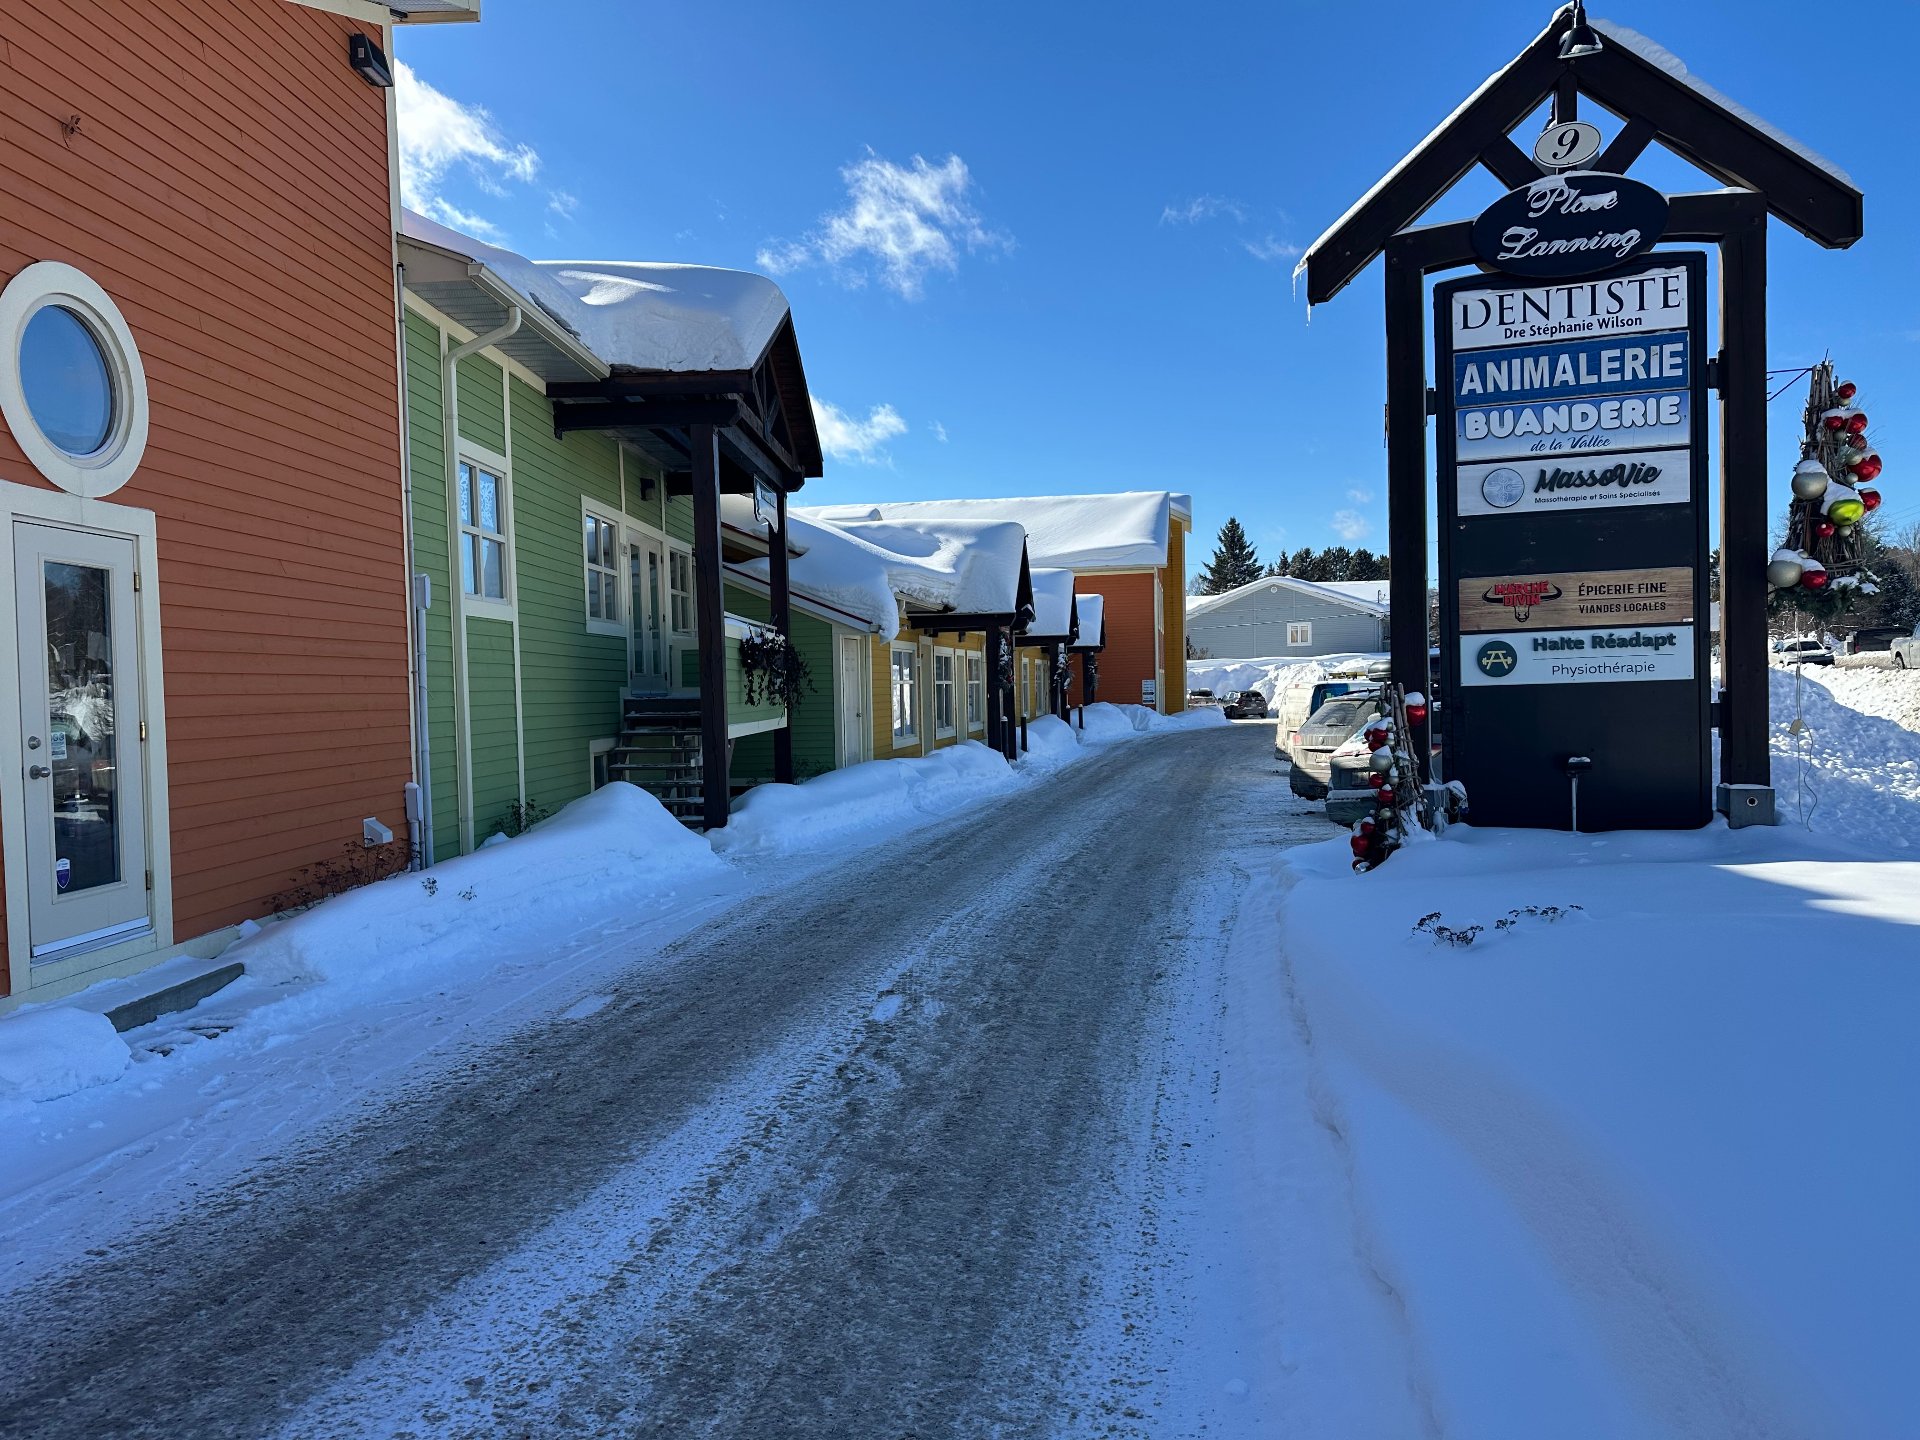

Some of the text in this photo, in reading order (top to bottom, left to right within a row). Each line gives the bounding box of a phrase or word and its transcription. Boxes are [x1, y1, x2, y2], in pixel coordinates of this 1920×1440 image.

[1551, 128, 1581, 160] 9
[1526, 184, 1619, 218] Plae
[1497, 226, 1641, 260] Lanning
[1460, 275, 1681, 331] DENTISTE
[1504, 315, 1643, 340] Dre Stéphanie Wilson
[1460, 342, 1684, 396] ANIMALERIE
[1464, 395, 1681, 440] BUANDERIE
[1530, 434, 1612, 452] de la Vallée
[1533, 462, 1663, 493] MassoVie
[1534, 494, 1588, 504] Massothérapie
[1599, 492, 1618, 500] Soins
[1503, 593, 1541, 607] DIVIN
[1578, 582, 1667, 597] ÉPICERIE FINE
[1579, 601, 1666, 614] VIANDES LOCALES
[1533, 631, 1677, 652] Halte Réadapt
[1552, 661, 1656, 678] Physiothérapie
